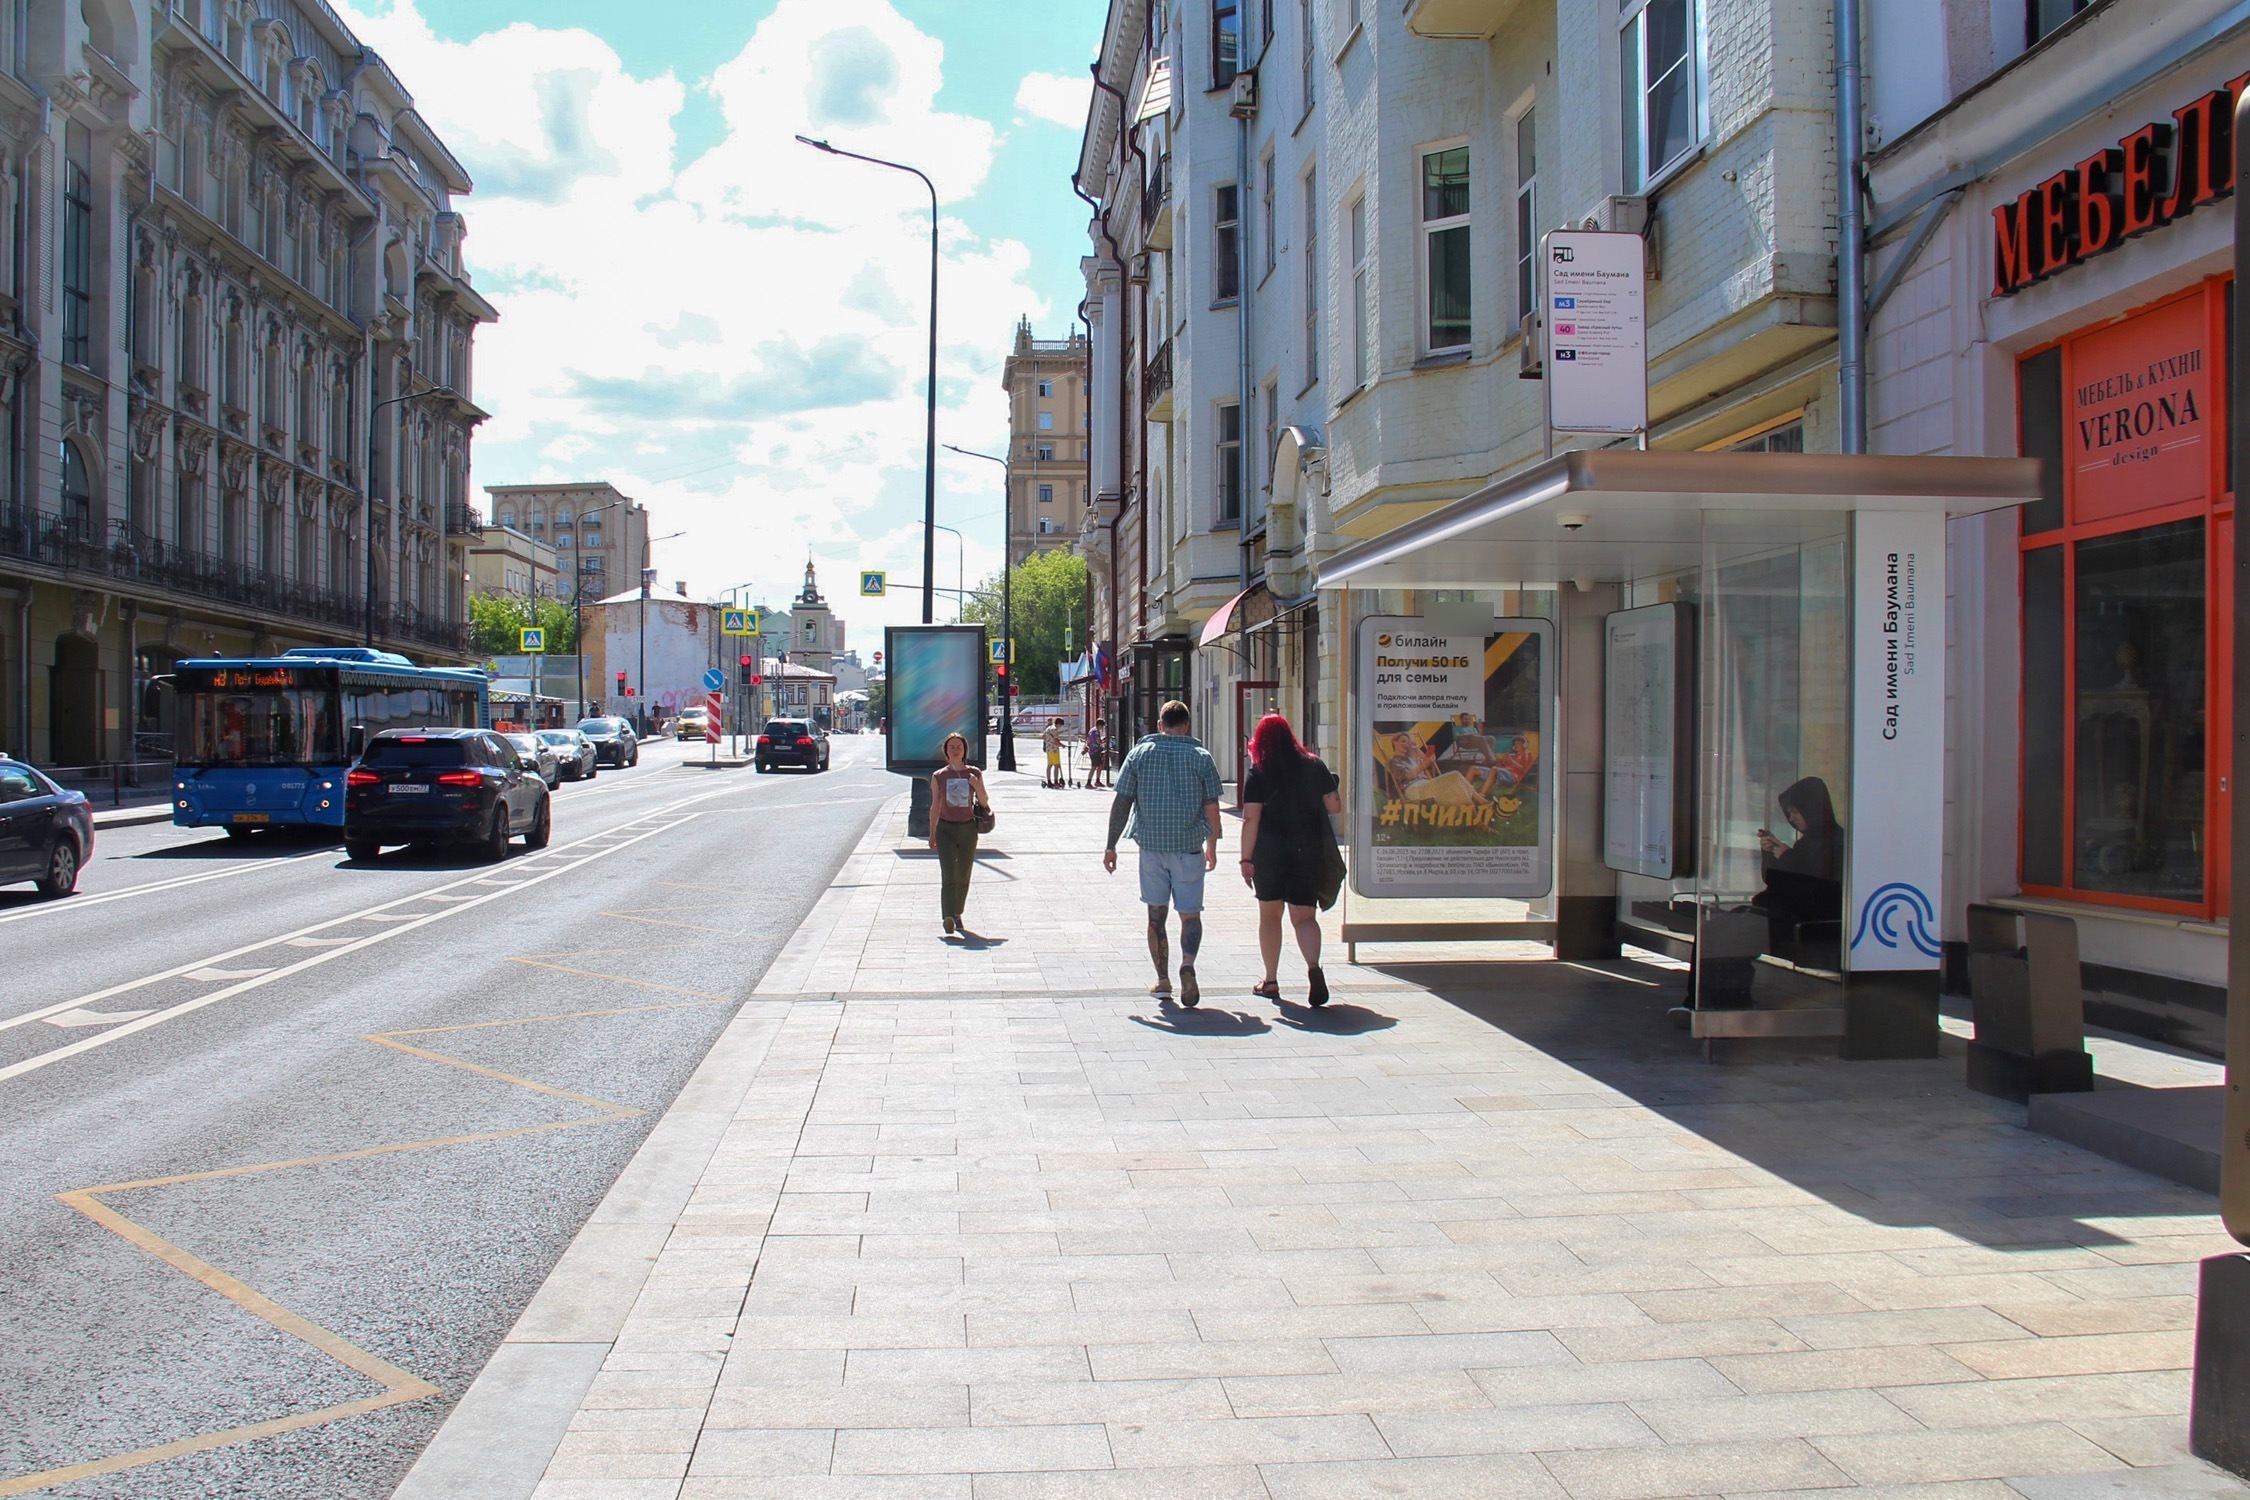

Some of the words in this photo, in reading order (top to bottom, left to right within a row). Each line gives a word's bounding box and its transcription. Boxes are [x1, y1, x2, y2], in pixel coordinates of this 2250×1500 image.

[1553, 269, 1568, 278] Сад
[1596, 271, 1630, 279] Баумана
[1560, 325, 1571, 334] 40
[2078, 372, 2133, 408] МЕБЕЛЬ
[2137, 374, 2143, 389] &
[2148, 349, 2201, 385] КУХНИ
[2079, 388, 2200, 452] VERONA
[2112, 446, 2158, 465] design
[1904, 553, 1915, 609] Baumana
[1883, 552, 1901, 634] Баумана
[1904, 613, 1915, 649] Imeni
[1395, 634, 1447, 648] билайн
[1377, 655, 1428, 670] Получи
[1432, 656, 1449, 668] 50
[1453, 656, 1469, 668] Гб
[1886, 639, 1898, 699] имени
[1904, 652, 1914, 675] Sad
[1377, 673, 1402, 685] для
[1405, 673, 1448, 683] семьи
[1377, 693, 1416, 702] Подключи
[1446, 695, 1468, 703] пчелу
[993, 707, 1015, 715] СТП
[1883, 704, 1899, 740] Сад
[1376, 834, 1391, 842] 12+
